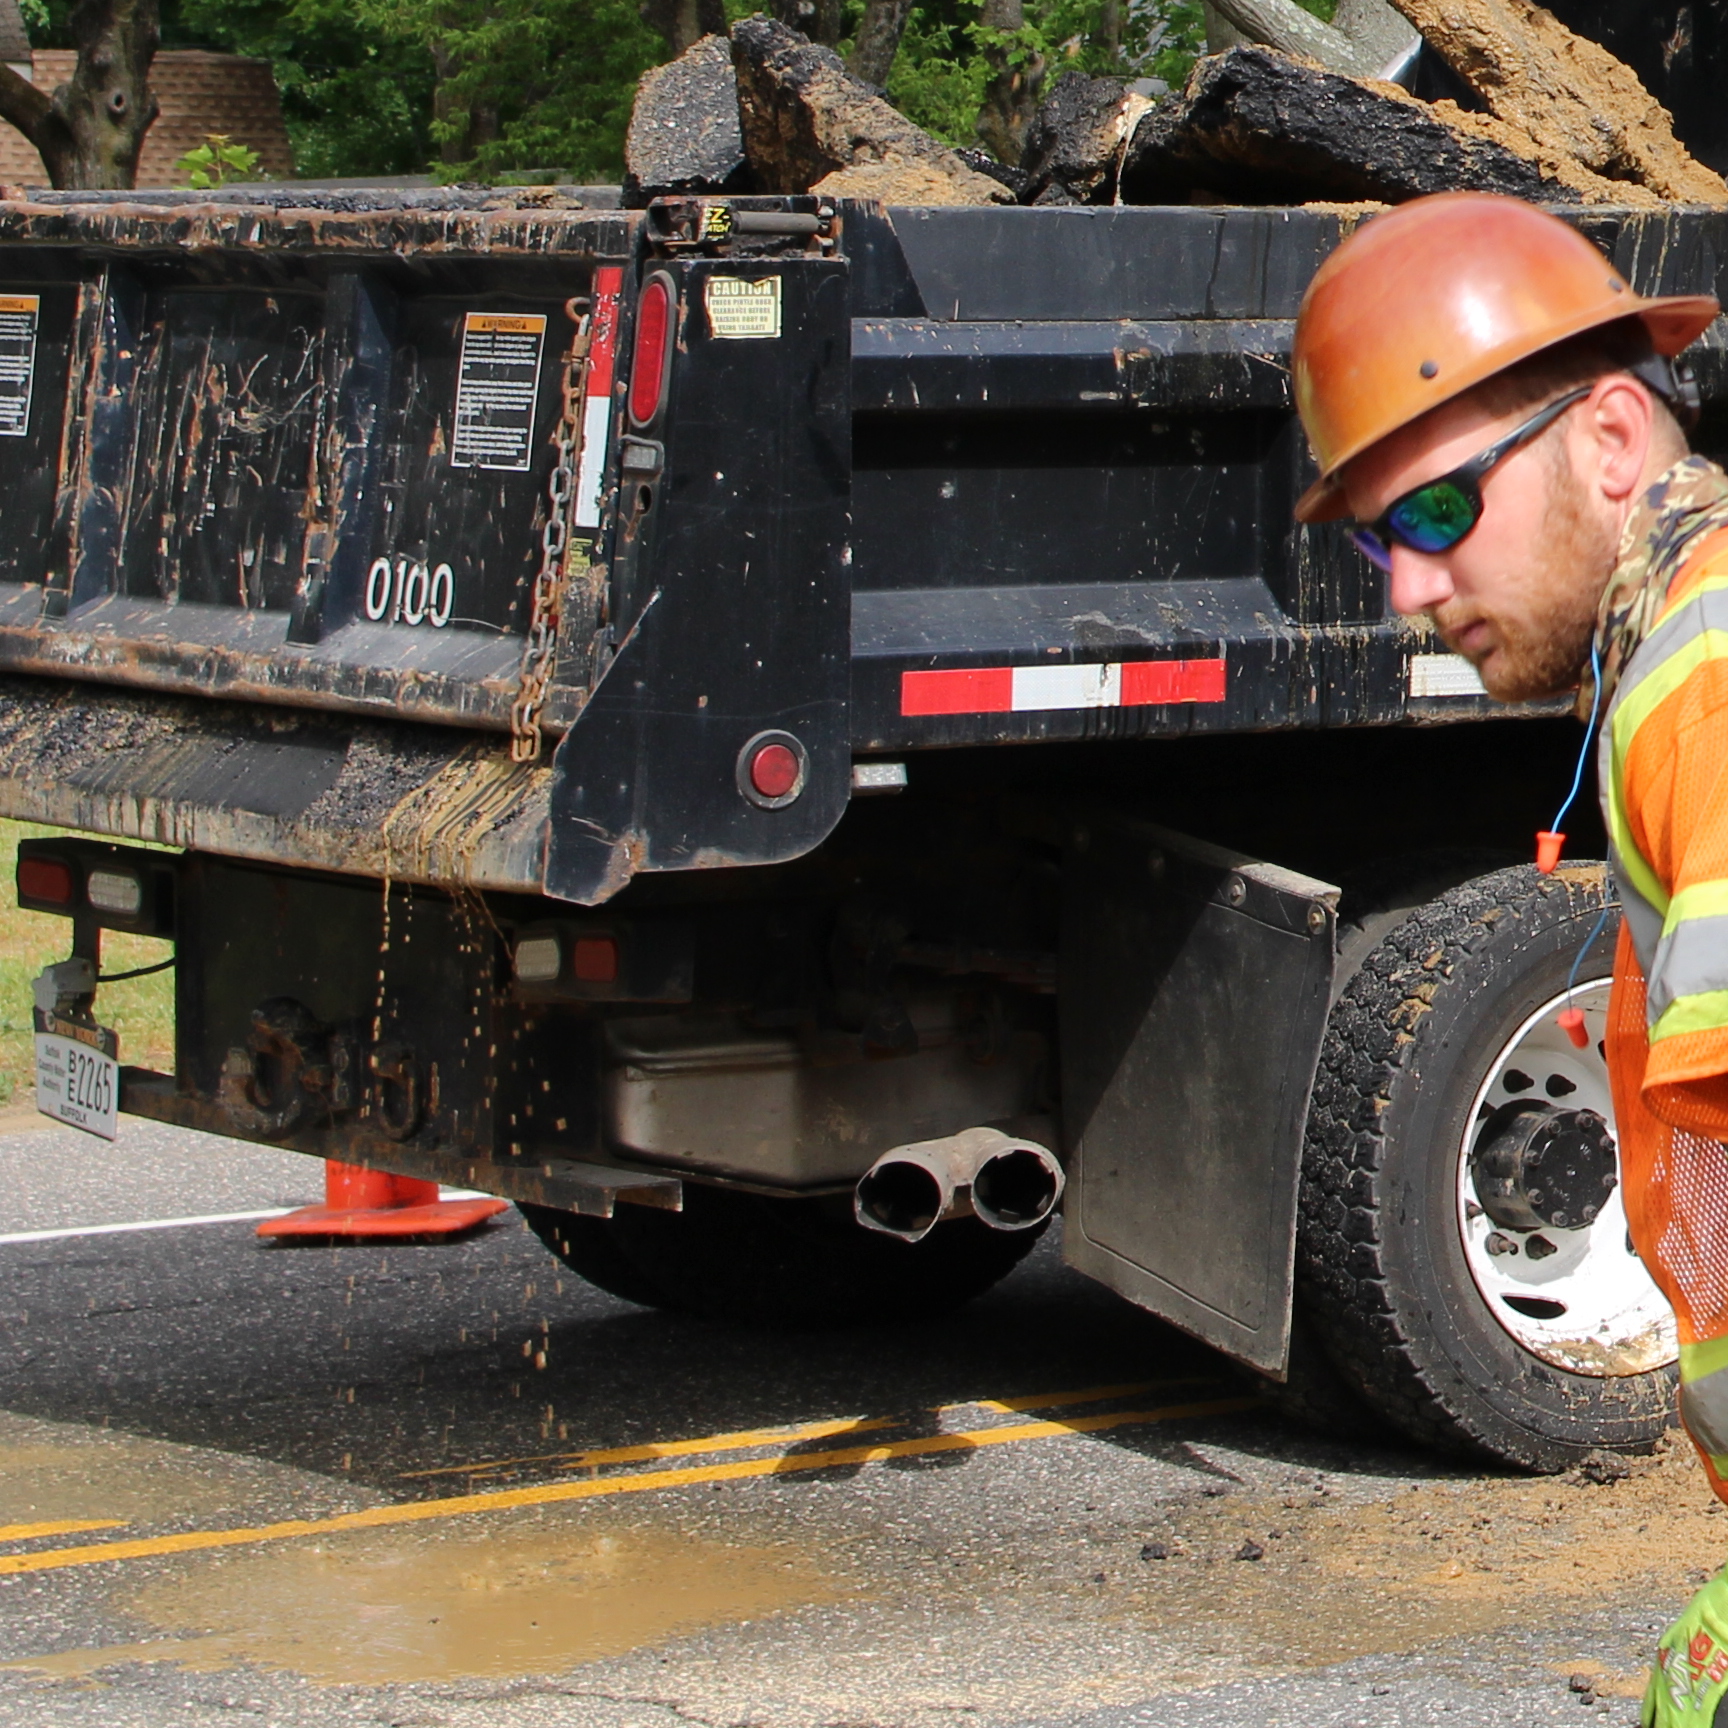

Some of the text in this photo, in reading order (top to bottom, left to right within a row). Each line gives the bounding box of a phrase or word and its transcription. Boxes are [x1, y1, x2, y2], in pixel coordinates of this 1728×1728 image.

[713, 281, 772, 295] CAUTION
[487, 319, 521, 329] WARNING
[366, 557, 455, 627] 0100
[77, 1053, 111, 1115] 2265
[60, 1104, 87, 1124] SUFFOLK
